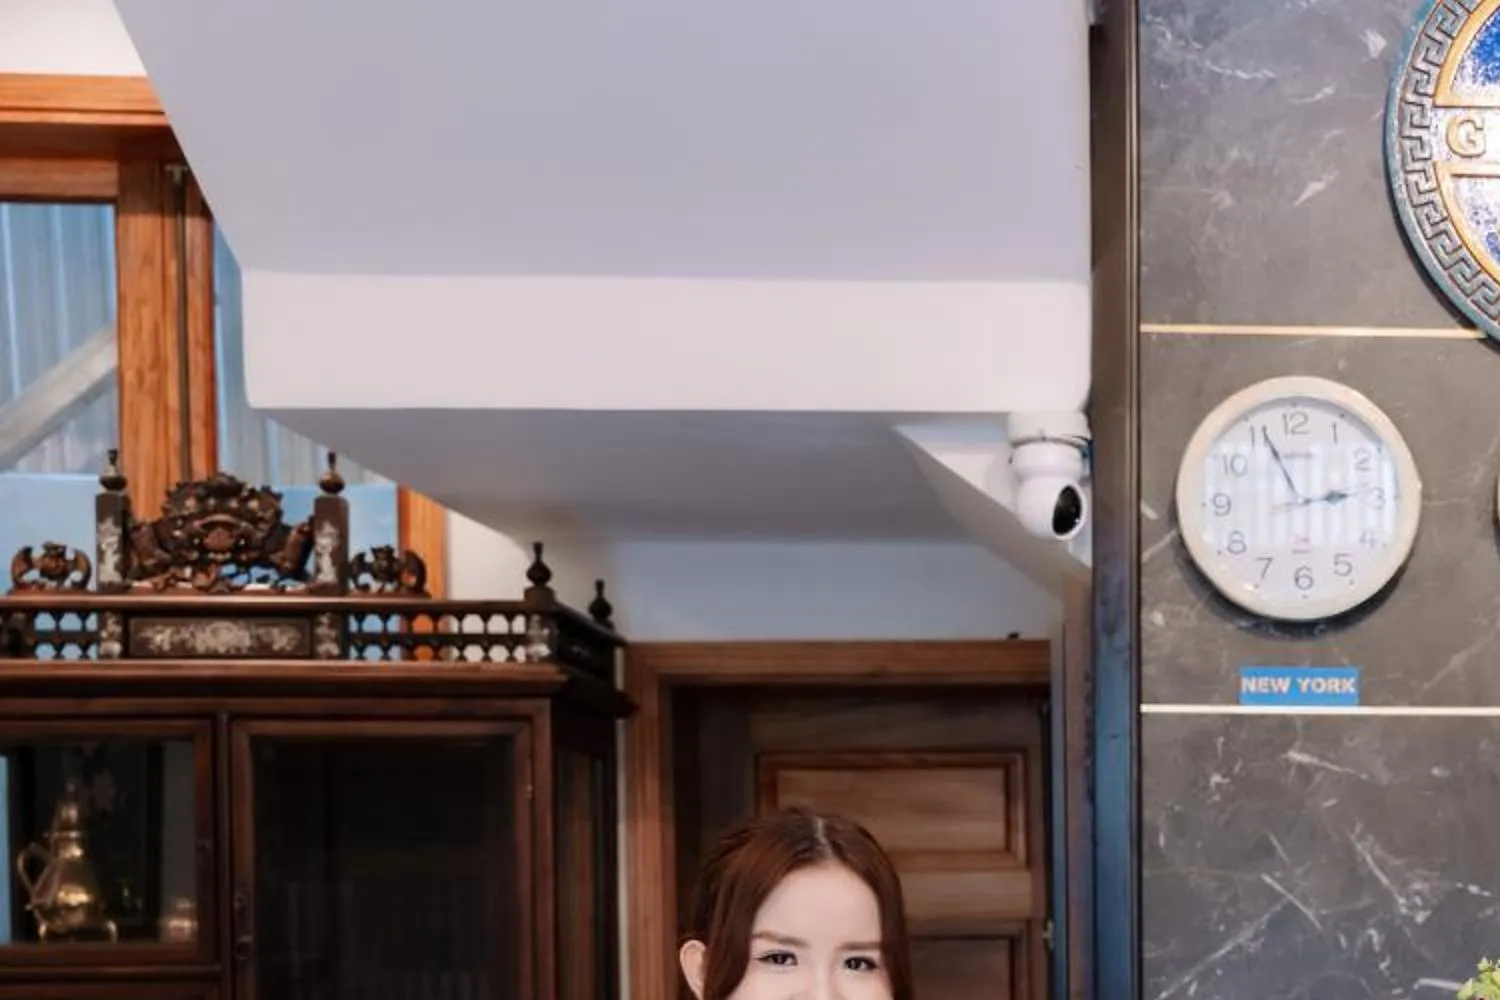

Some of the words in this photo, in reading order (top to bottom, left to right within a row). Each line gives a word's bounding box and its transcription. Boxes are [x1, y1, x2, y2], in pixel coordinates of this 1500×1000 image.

[1282, 411, 1309, 435] 12
[1329, 423, 1338, 445] 1
[1223, 454, 1248, 477] 10
[1354, 449, 1371, 471] 2
[1212, 493, 1232, 517] 9
[1227, 531, 1247, 555] 8
[1255, 557, 1274, 580] 7
[1333, 553, 1353, 576] 5
[1295, 566, 1314, 590] 6
[1241, 677, 1290, 693] NEW
[1296, 677, 1355, 693] YORK
